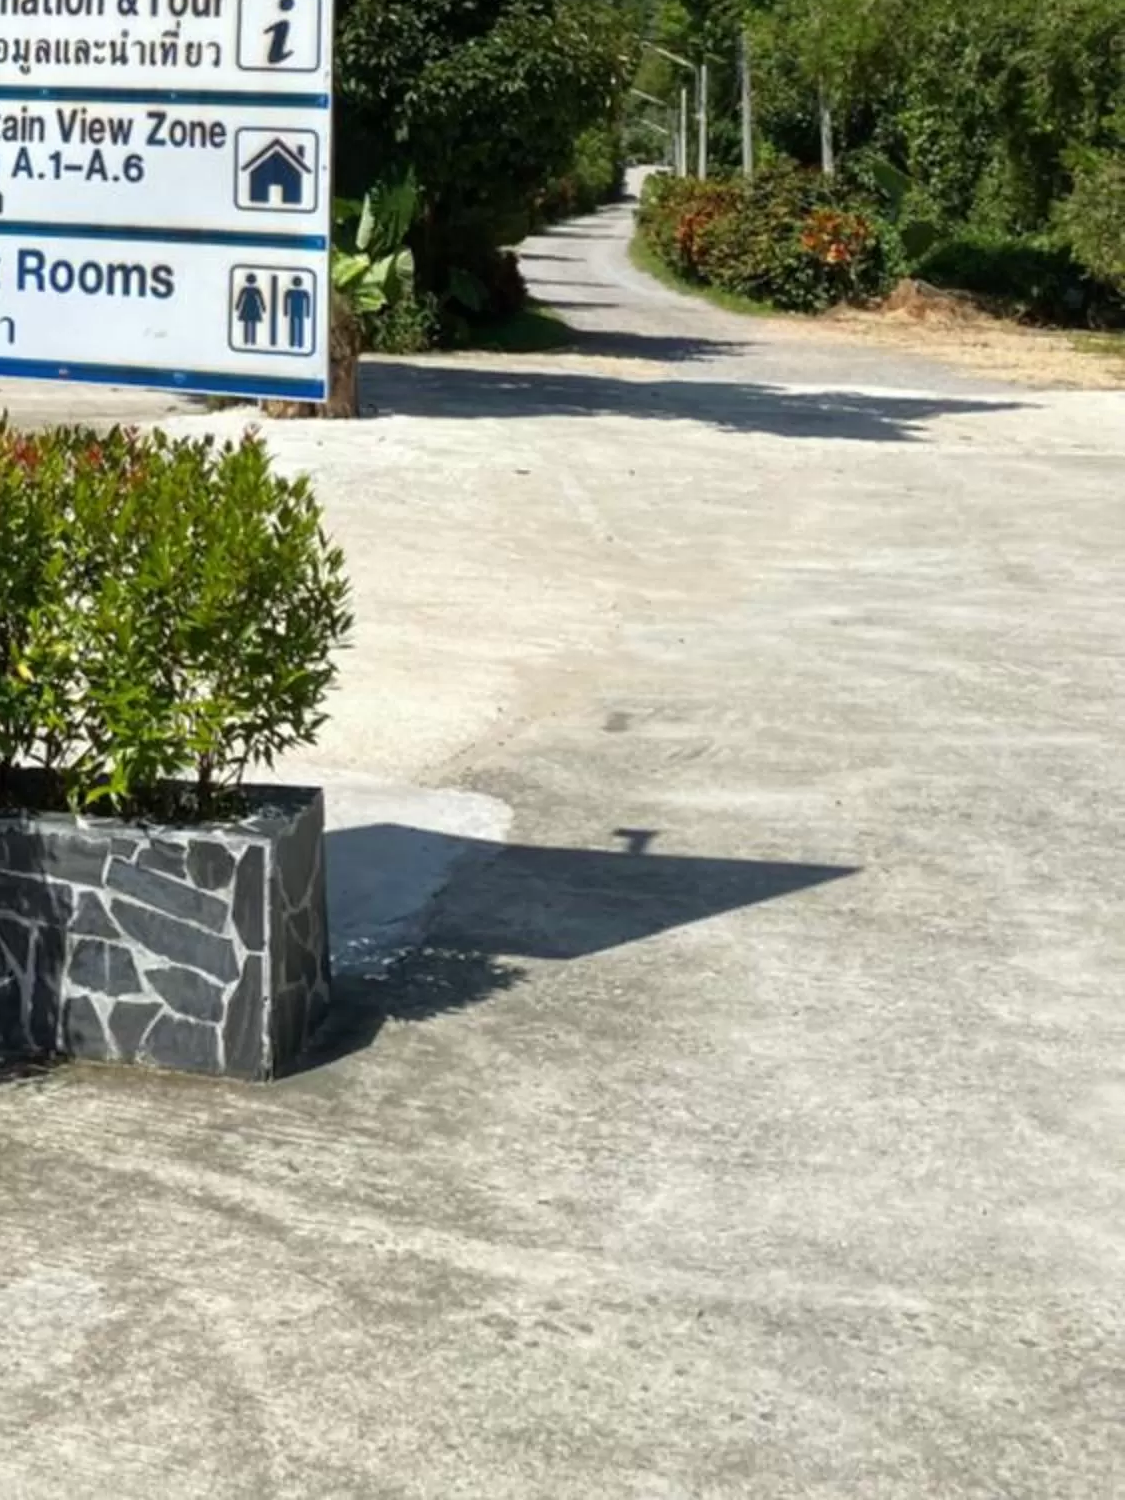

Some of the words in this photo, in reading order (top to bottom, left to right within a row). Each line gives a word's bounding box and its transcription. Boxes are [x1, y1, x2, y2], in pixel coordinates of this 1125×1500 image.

[56, 108, 134, 146] View
[145, 111, 228, 150] Zone
[16, 249, 175, 300] Rooms
